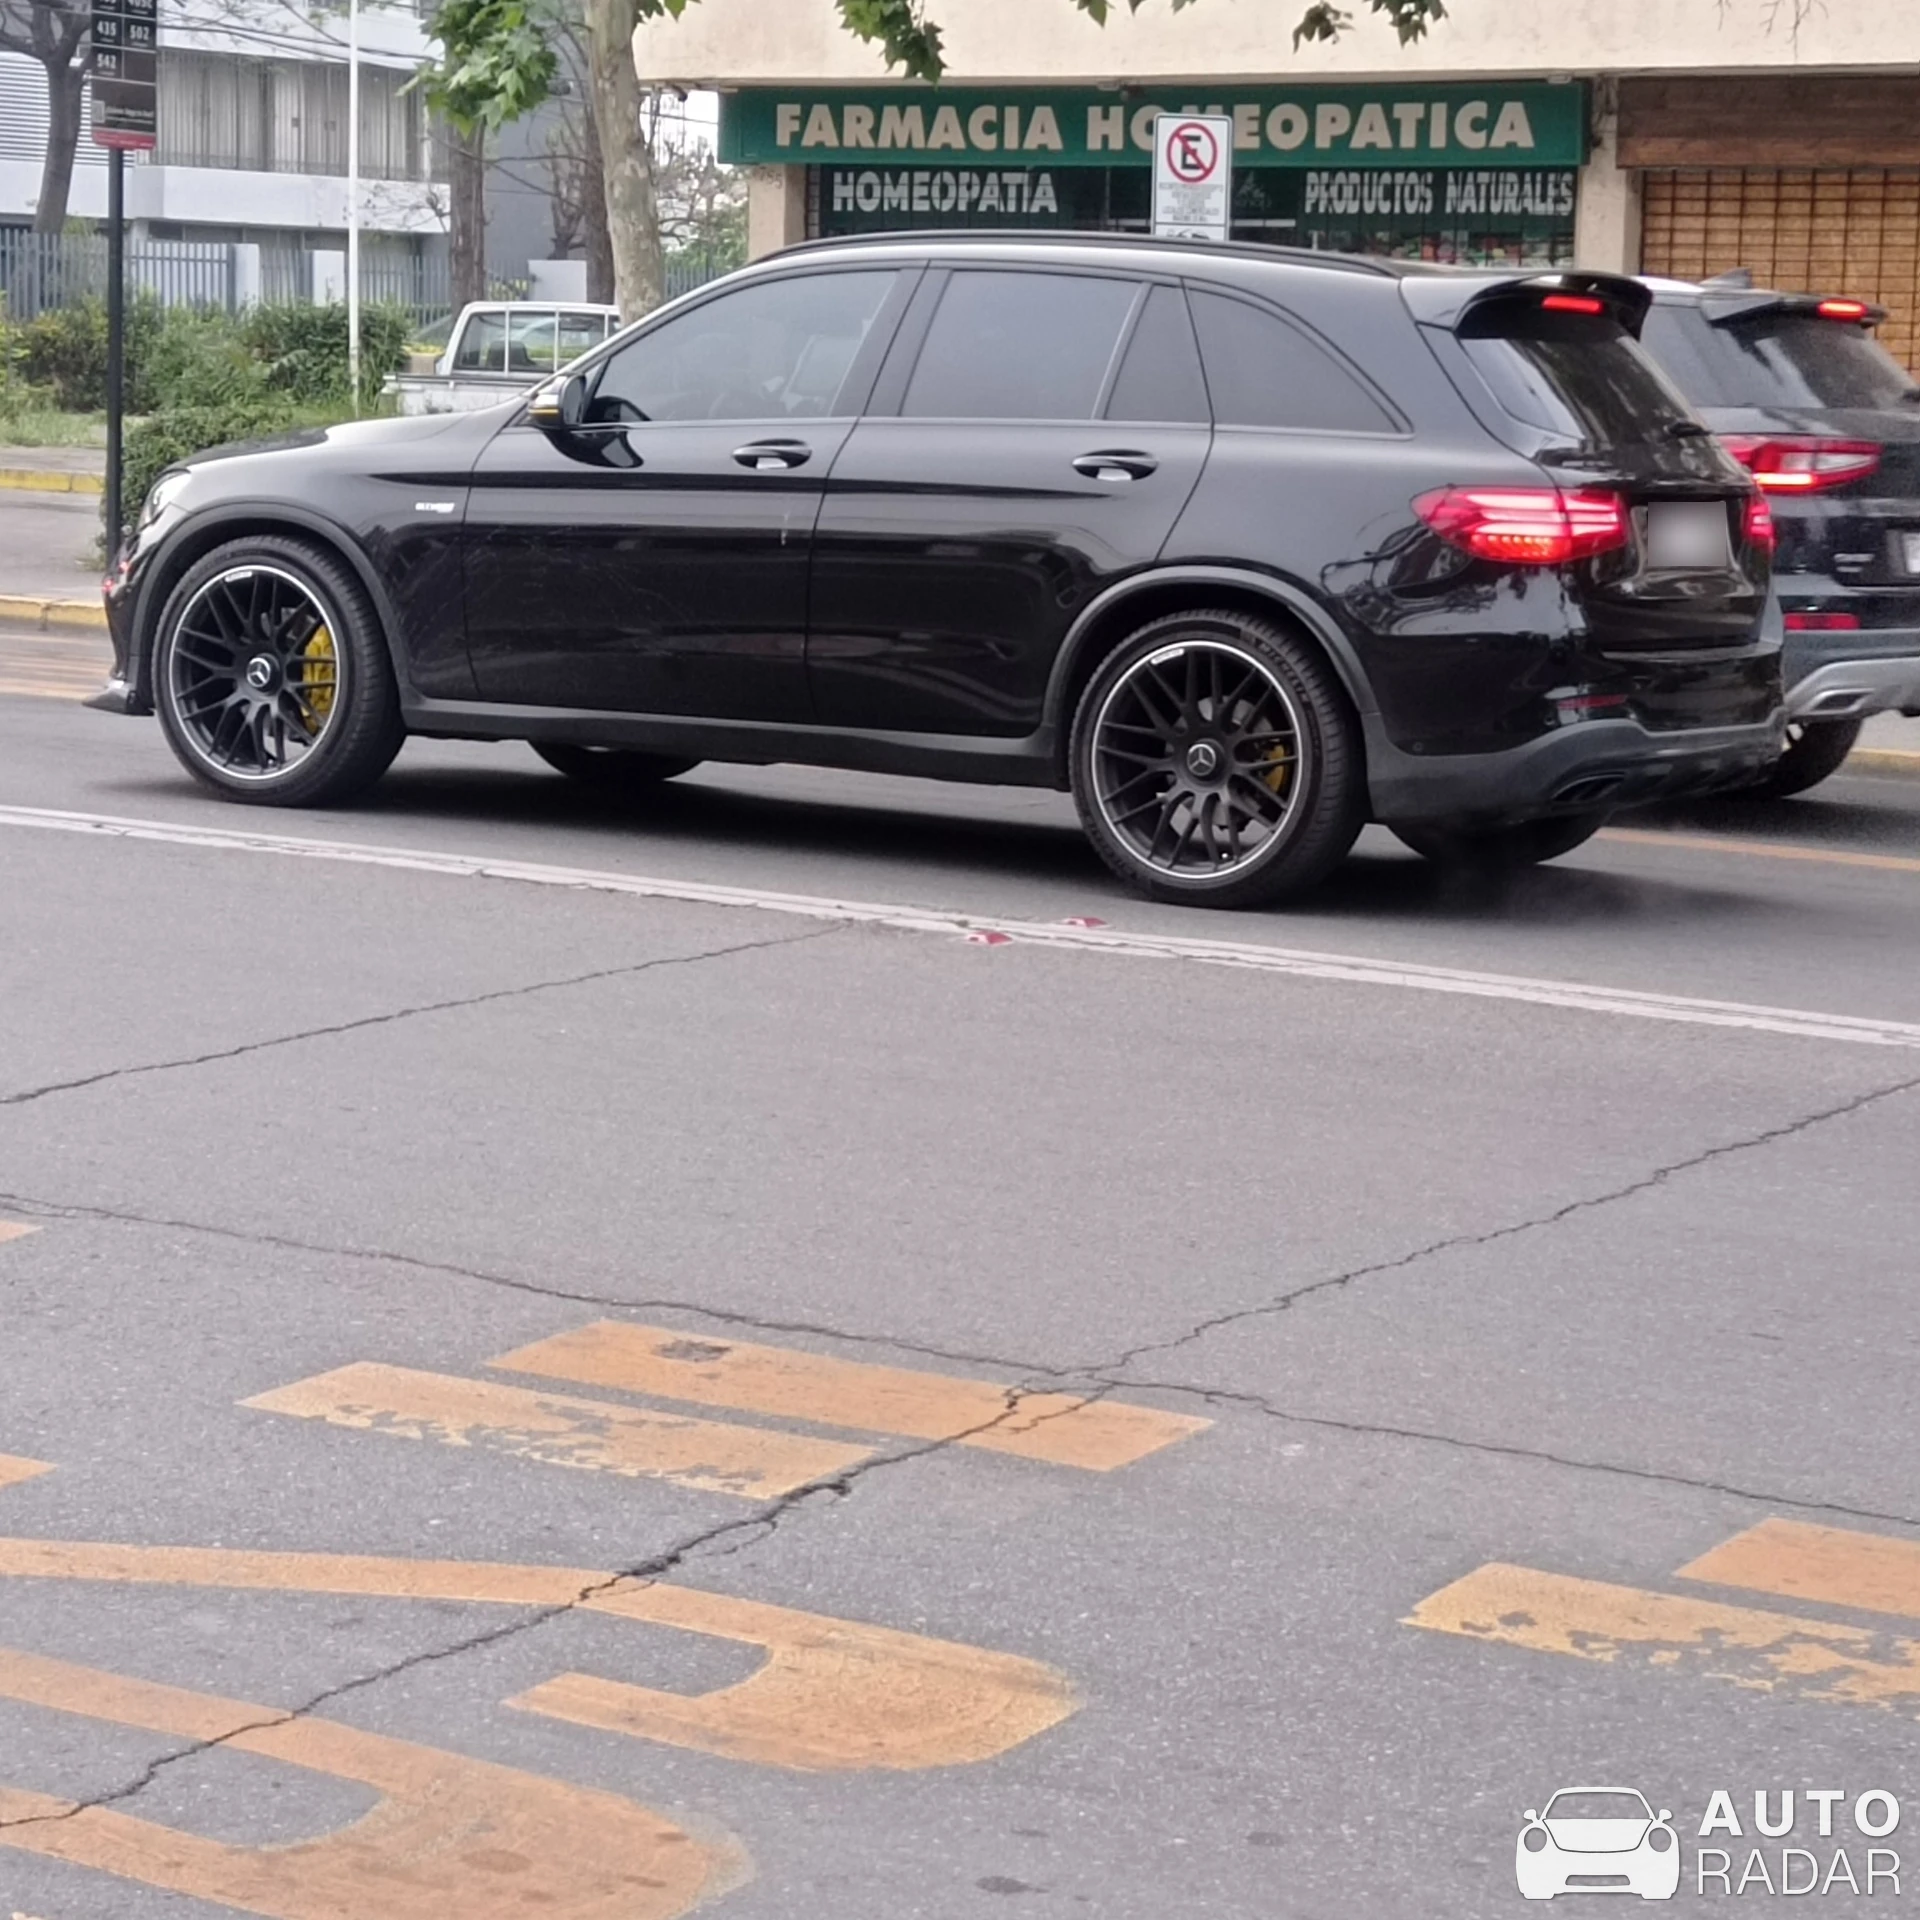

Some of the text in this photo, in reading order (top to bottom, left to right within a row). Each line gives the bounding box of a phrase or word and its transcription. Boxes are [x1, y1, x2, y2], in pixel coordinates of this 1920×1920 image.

[130, 24, 150, 40] 502
[97, 53, 116, 69] 542
[776, 101, 1535, 151] FARMACIA HOEOPATICA
[1304, 171, 1433, 214] PRODUCTOS
[1445, 171, 1574, 216] NATURALES
